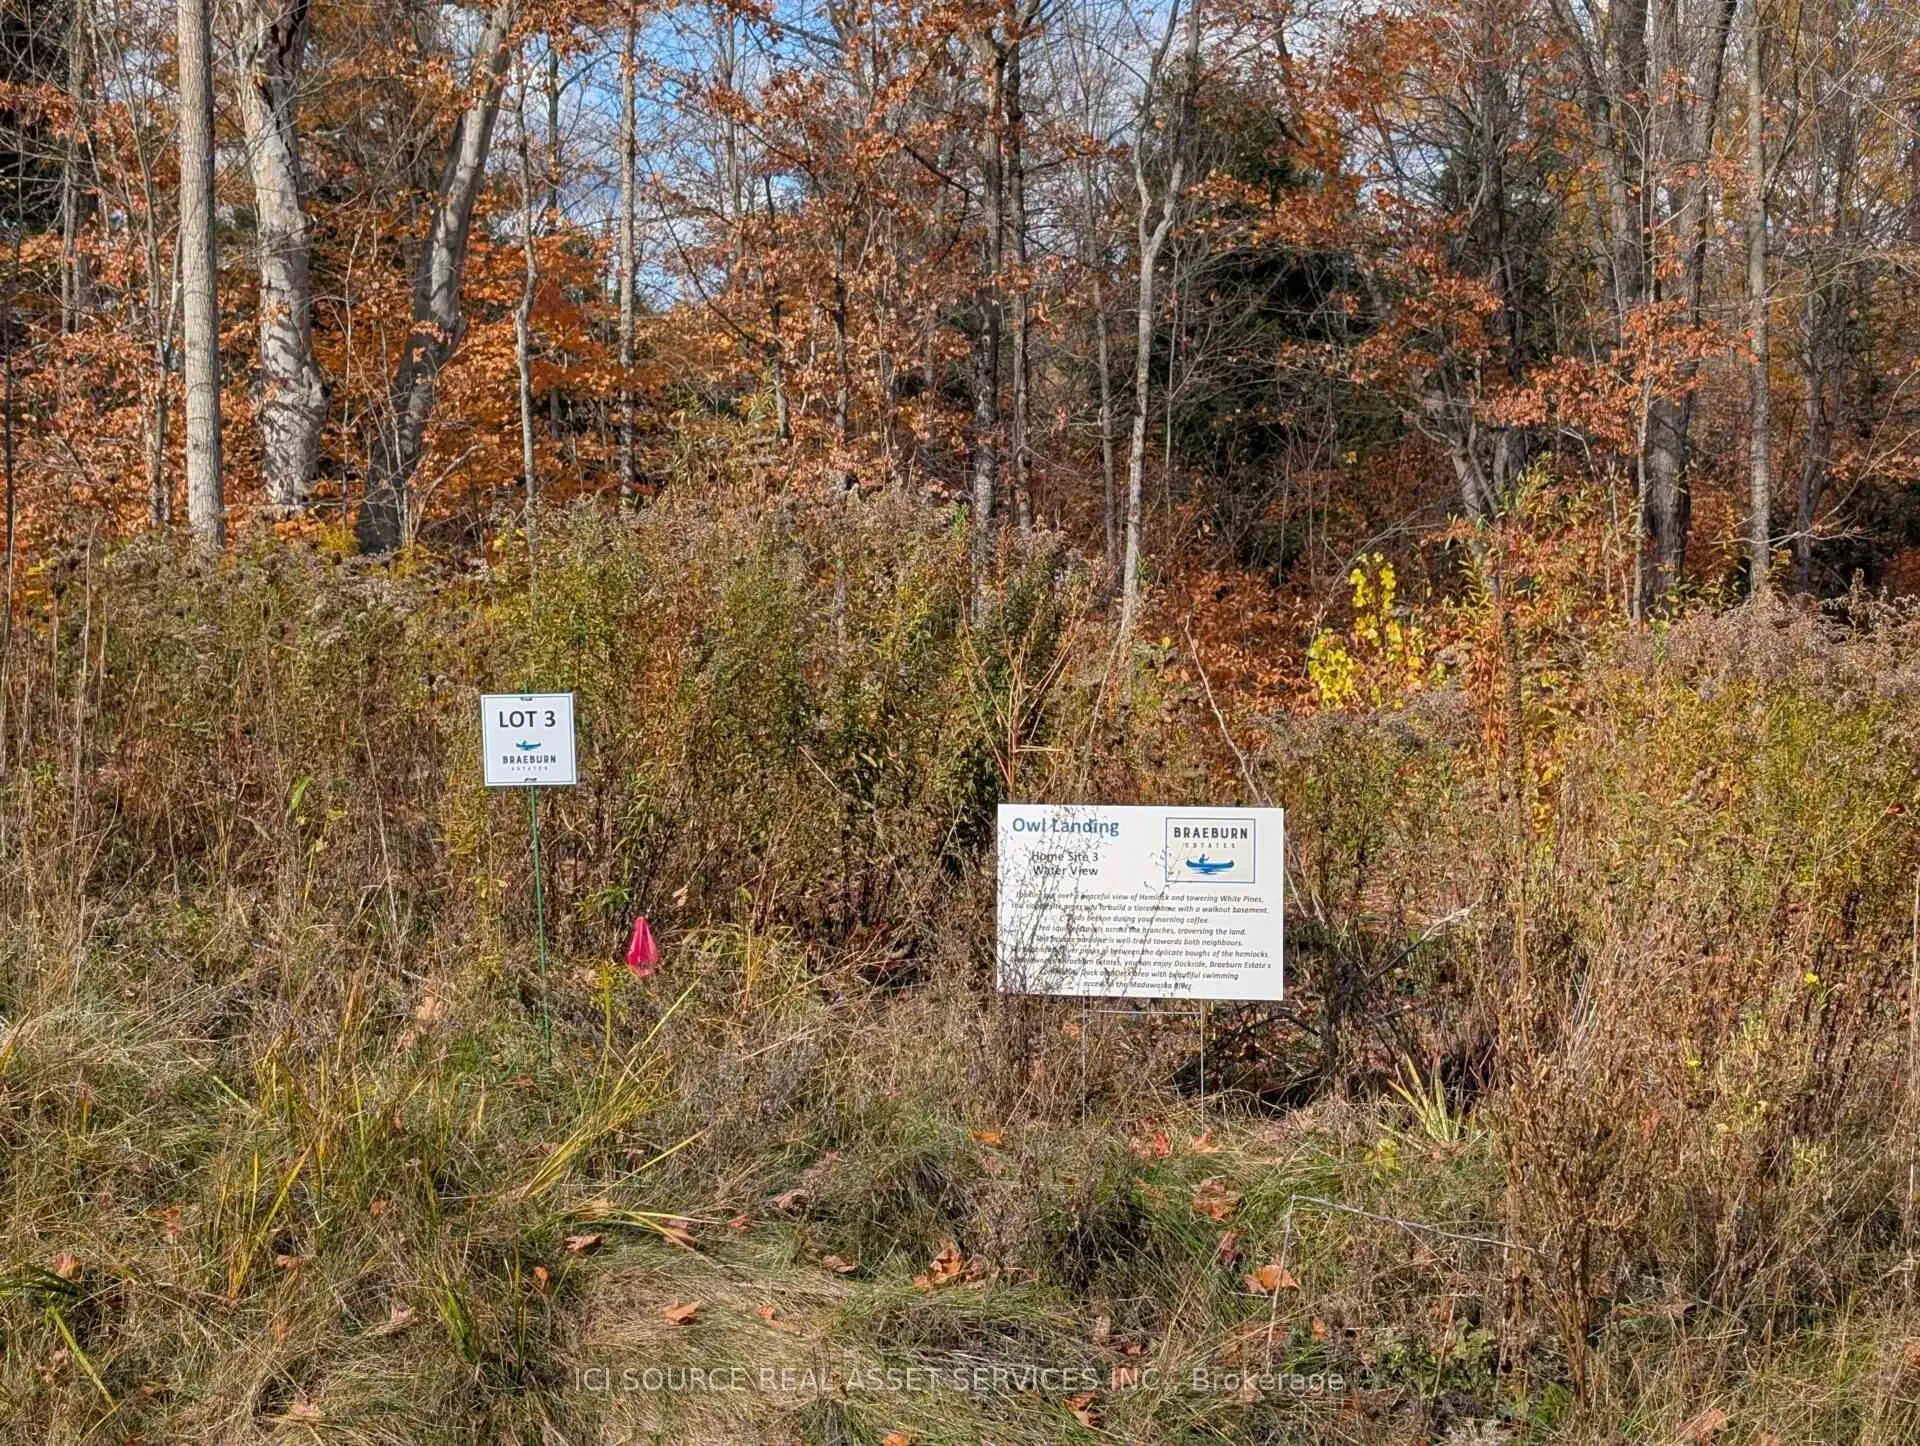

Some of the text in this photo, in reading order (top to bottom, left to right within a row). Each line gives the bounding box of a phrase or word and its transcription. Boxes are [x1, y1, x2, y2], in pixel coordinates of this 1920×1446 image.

[499, 710, 556, 728] LOT 3
[502, 754, 557, 765] BRAEBURN
[1012, 817, 1120, 837] Owl Landing
[1173, 826, 1248, 840] BRAEBURN
[1184, 841, 1236, 849] ESTATES
[1031, 850, 1099, 862] Home Site 3
[1032, 864, 1098, 876] Water View
[1187, 894, 1218, 904] towering
[1219, 895, 1242, 903] White
[1177, 905, 1194, 913] with
[1201, 905, 1231, 914] walkout
[1155, 916, 1185, 925] morning
[1177, 927, 1214, 937] traversing
[1215, 928, 1228, 936] the
[1155, 948, 1184, 957] delicate
[1184, 949, 1210, 958] boughs
[1220, 949, 1233, 958] the
[1152, 960, 1173, 969] enjoy
[1209, 961, 1242, 969] Braeburn
[1151, 970, 1167, 978] with
[1202, 972, 1240, 981] swimming
